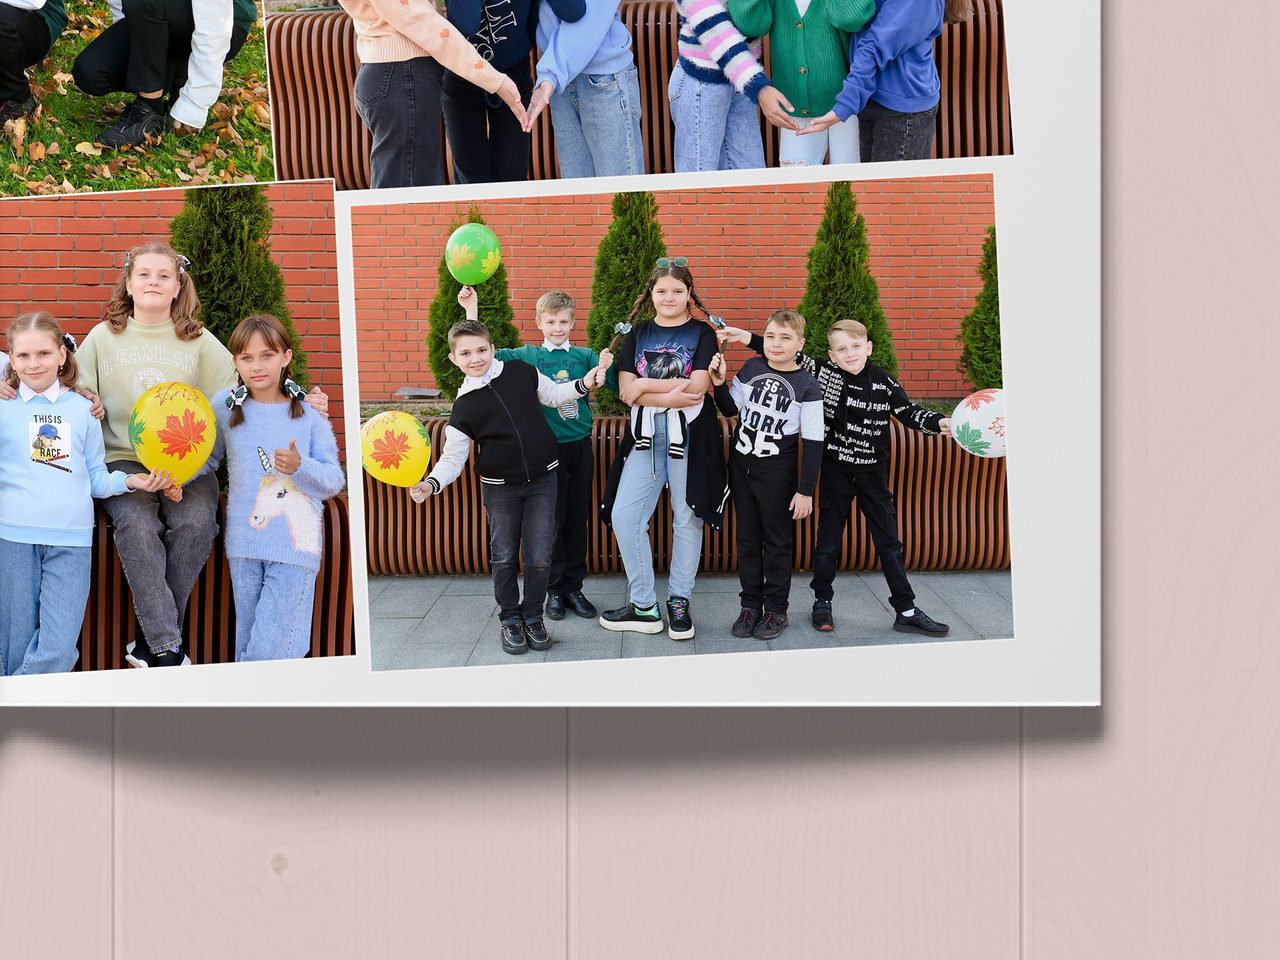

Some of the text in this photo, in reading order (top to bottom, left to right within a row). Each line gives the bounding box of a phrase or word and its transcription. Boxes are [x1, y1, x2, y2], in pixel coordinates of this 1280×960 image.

[764, 378, 780, 393] 56
[749, 387, 793, 414] NEW
[845, 396, 867, 408] Palm
[33, 414, 62, 425] THIS IS
